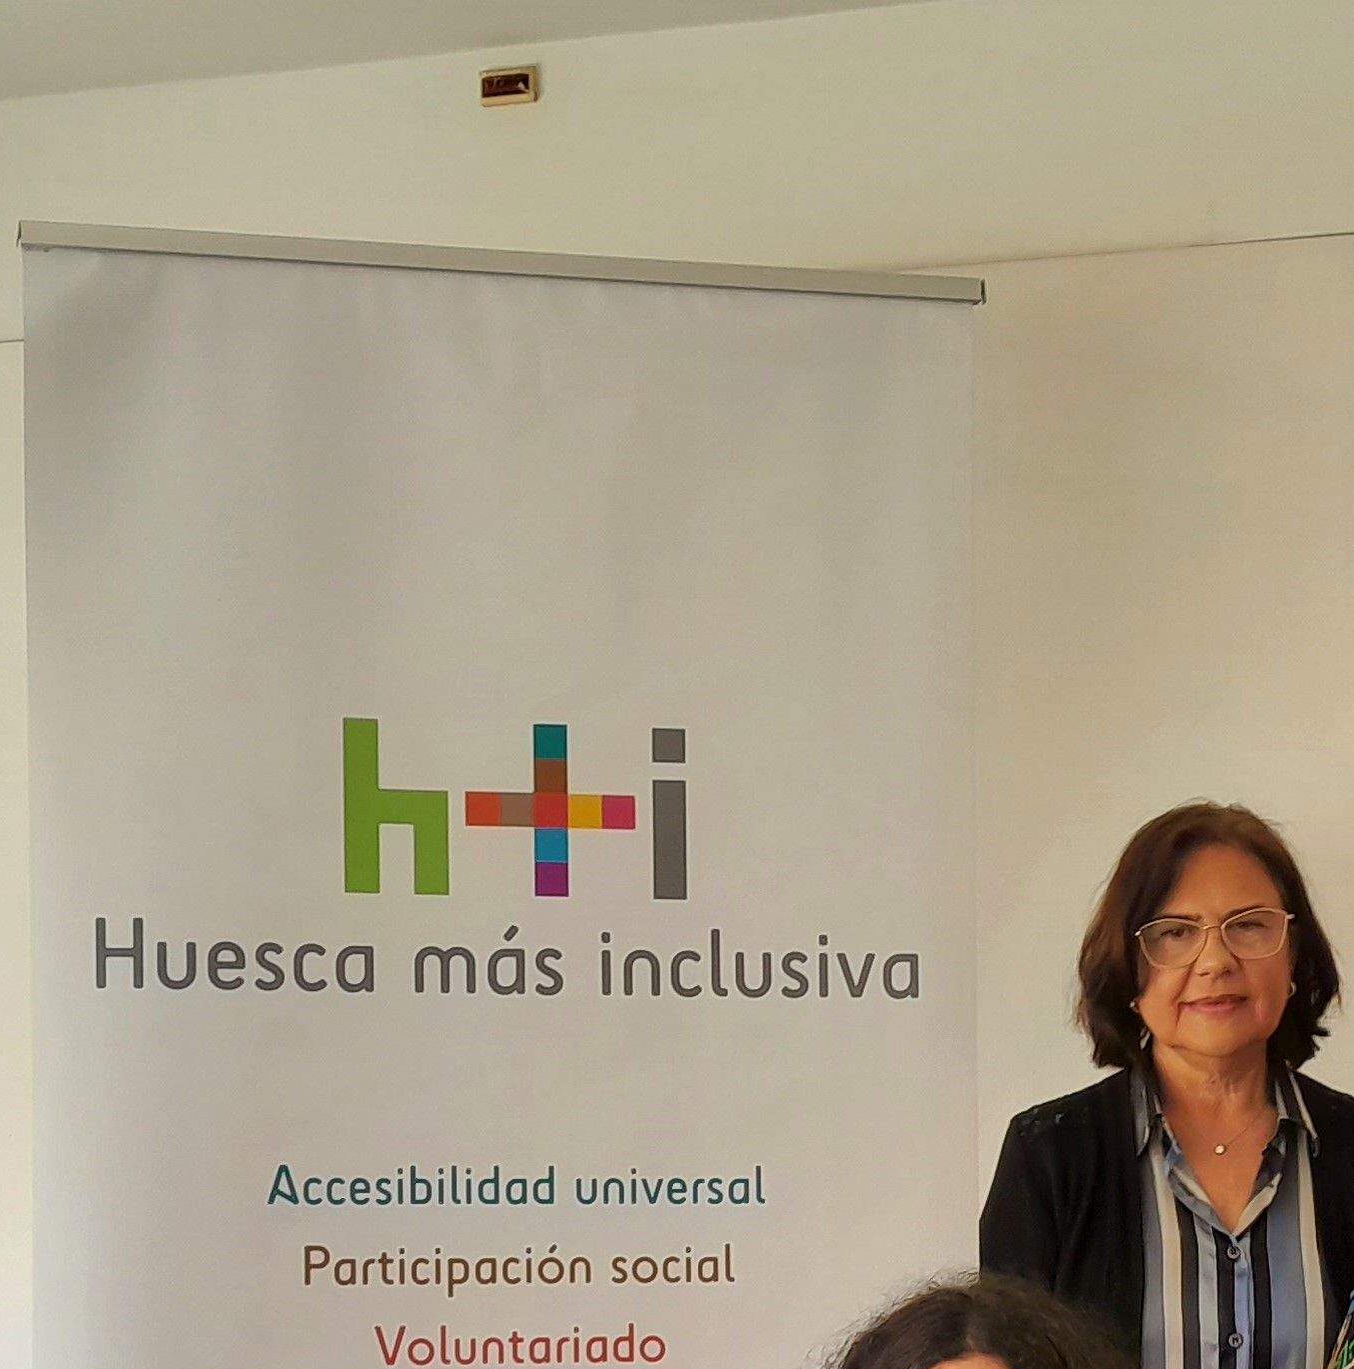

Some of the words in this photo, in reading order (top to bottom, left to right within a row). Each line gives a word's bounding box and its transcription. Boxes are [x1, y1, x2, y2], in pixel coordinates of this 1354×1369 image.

[95, 917, 375, 993] Huesca
[414, 925, 564, 996] más
[600, 929, 920, 999] inclusiva
[268, 1164, 555, 1205] Accesibilidad
[575, 1166, 766, 1205] universal
[303, 1245, 592, 1297] Participación
[611, 1244, 735, 1285] social
[374, 1323, 666, 1367] Voluntariado
